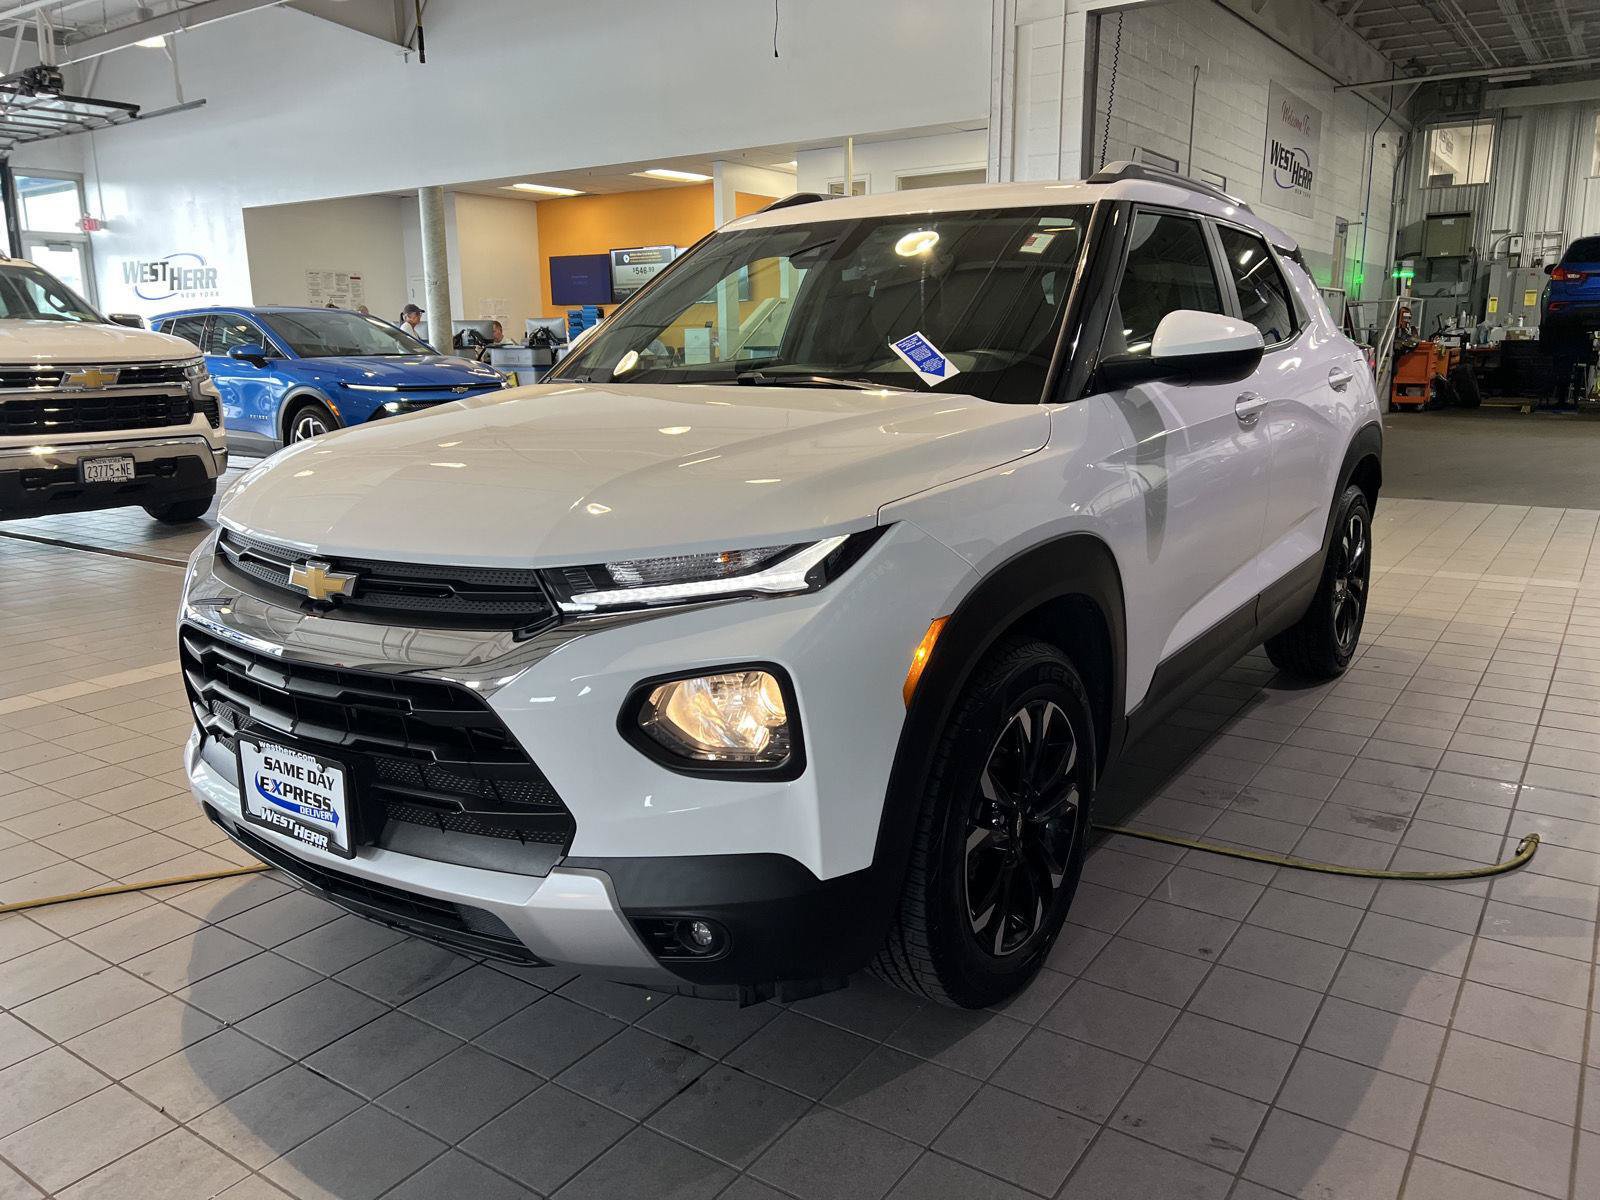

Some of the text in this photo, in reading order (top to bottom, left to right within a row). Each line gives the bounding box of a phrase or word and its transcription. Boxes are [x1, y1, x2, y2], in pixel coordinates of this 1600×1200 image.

[258, 741, 316, 763] westherr.com
[264, 756, 335, 791] SAME DAY
[260, 776, 332, 812] EXPRESS
[300, 806, 334, 821] DELIVERY
